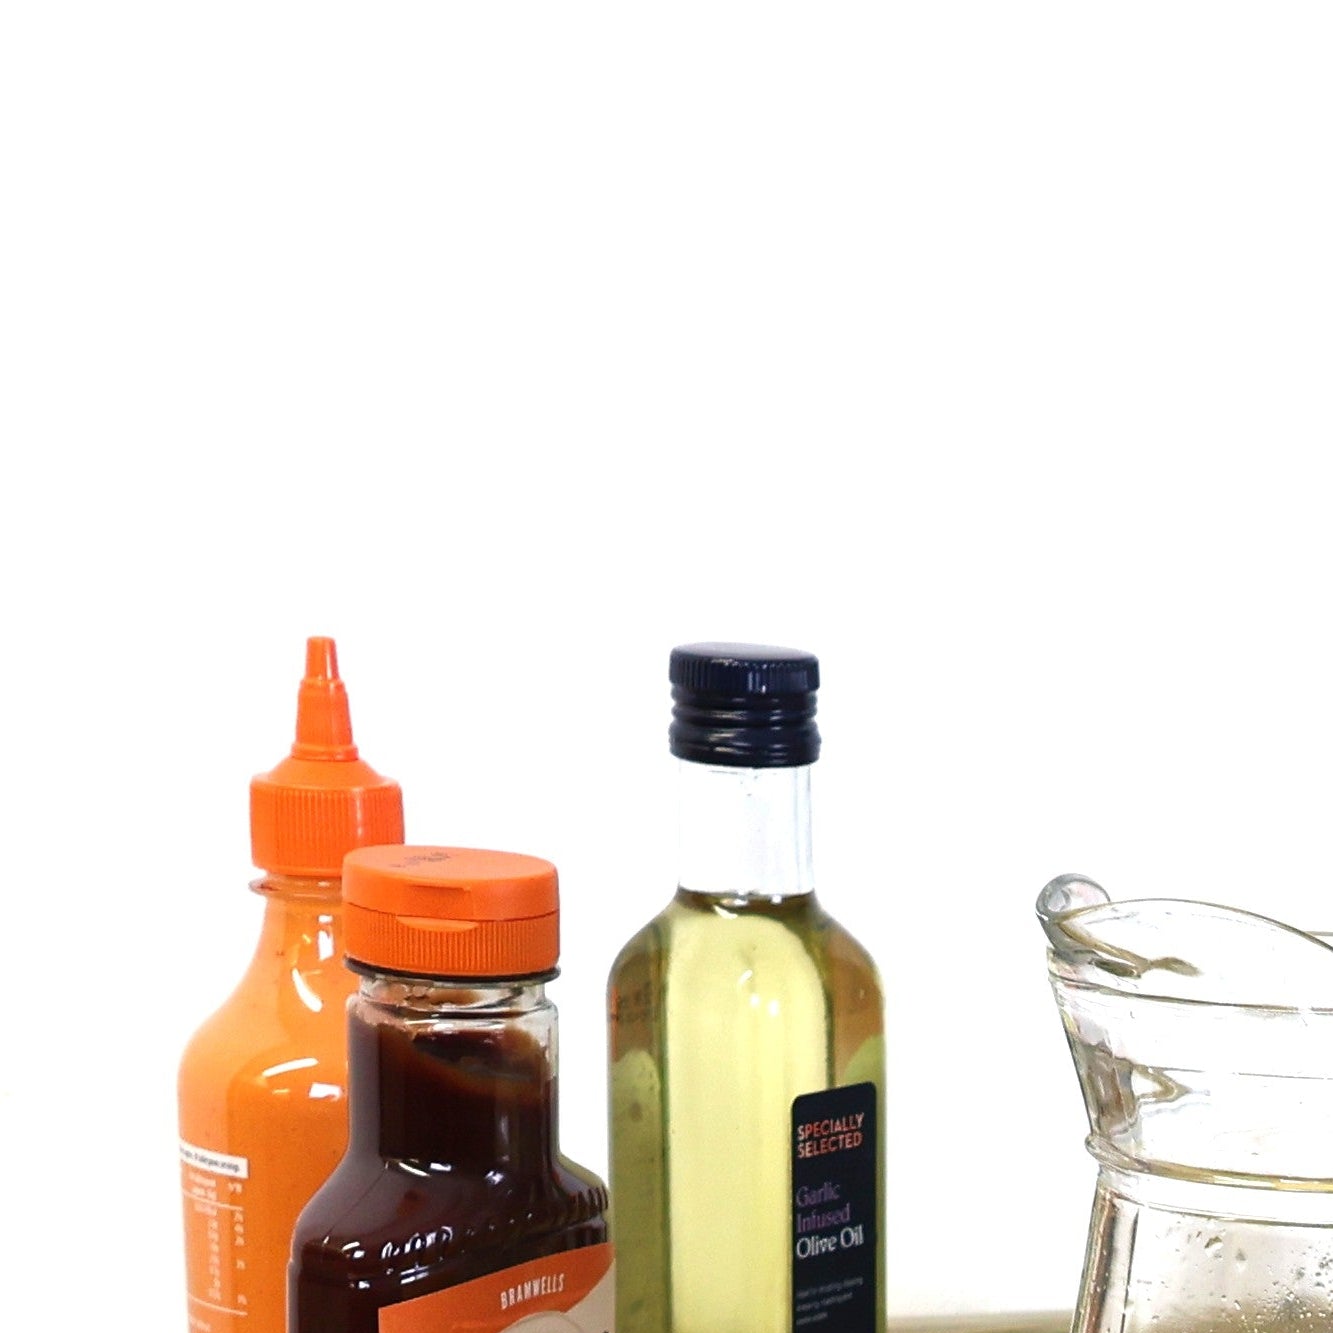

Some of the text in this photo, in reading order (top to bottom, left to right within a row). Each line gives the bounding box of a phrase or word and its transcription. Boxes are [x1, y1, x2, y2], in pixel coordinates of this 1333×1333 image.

[797, 1112, 864, 1141] SPECIALLY
[797, 1131, 863, 1159] SELECTED
[796, 1182, 840, 1209] Garlic
[796, 1203, 851, 1233] Infused
[796, 1224, 864, 1259] Olive Oil
[500, 1273, 565, 1310] BRAMWELLS
